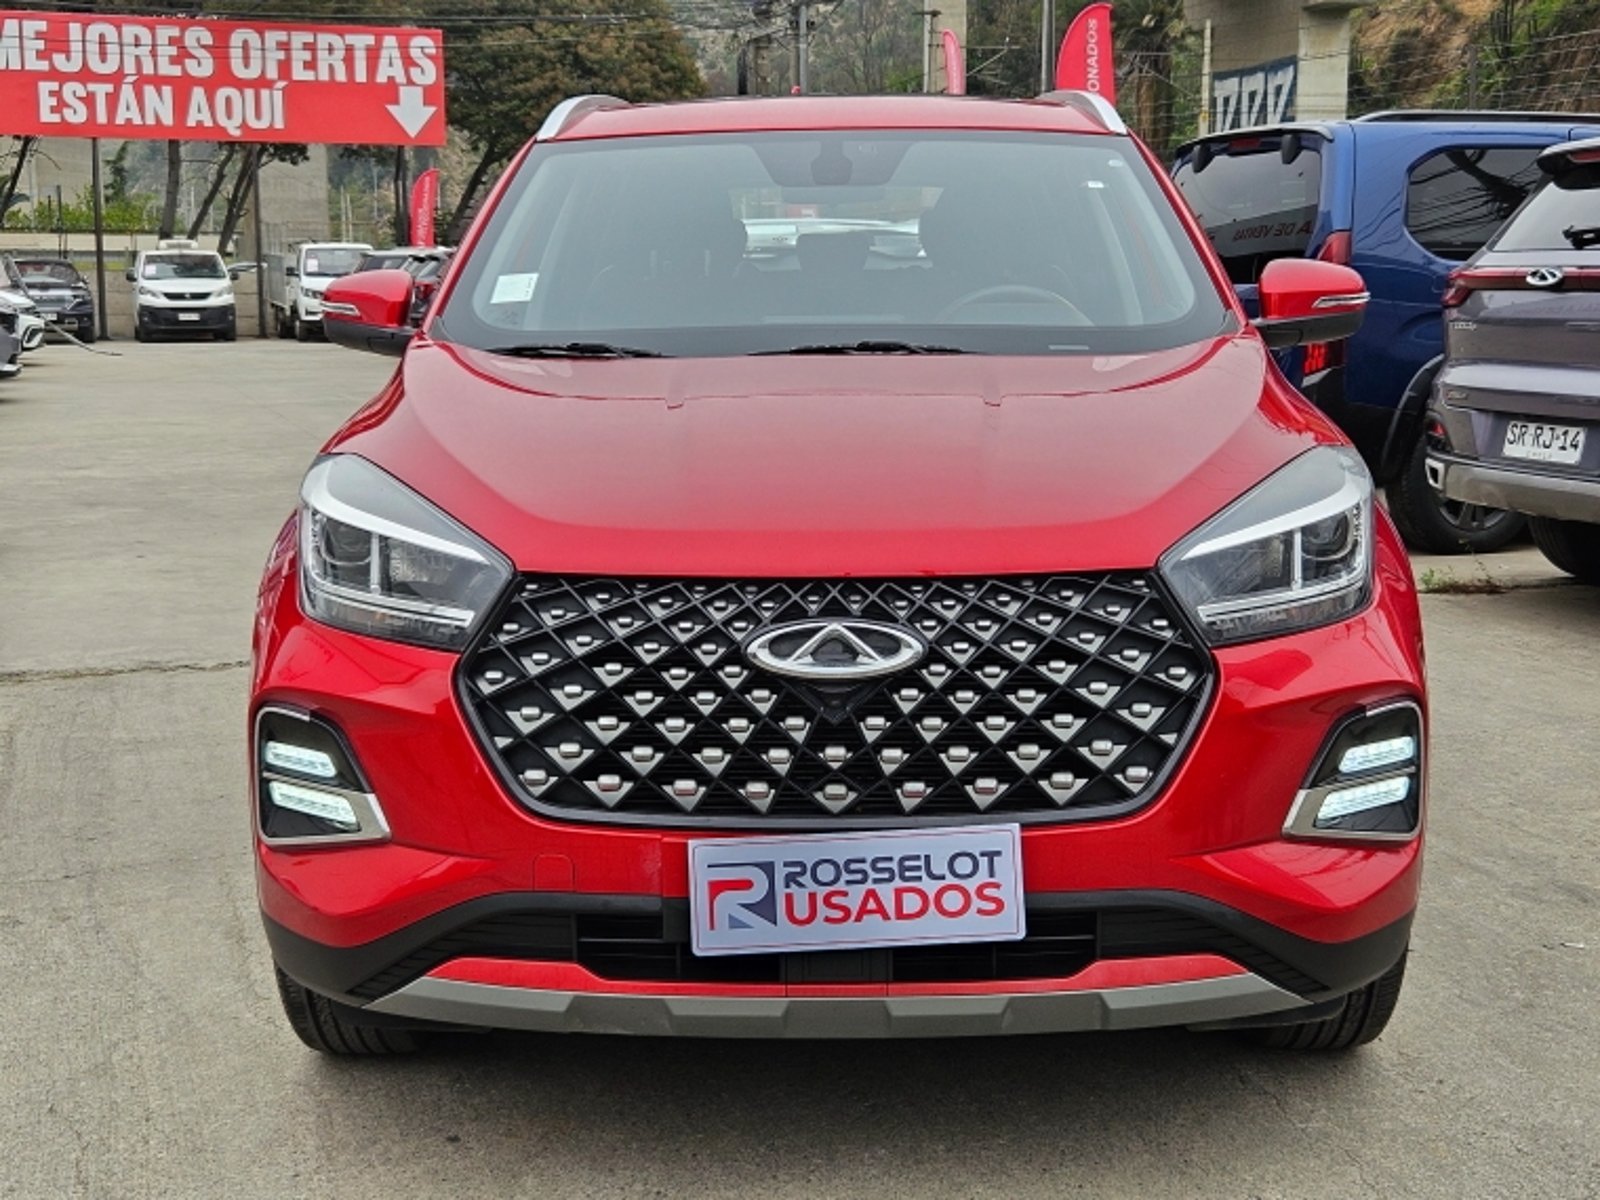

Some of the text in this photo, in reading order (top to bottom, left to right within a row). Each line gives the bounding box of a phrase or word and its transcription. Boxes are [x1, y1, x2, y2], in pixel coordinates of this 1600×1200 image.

[0, 18, 437, 85] MEJORES OFERTAS
[37, 75, 288, 137] ESTÁN AQUÍ
[783, 850, 1002, 889] ROSSELOT
[784, 882, 1005, 927] USADOS
